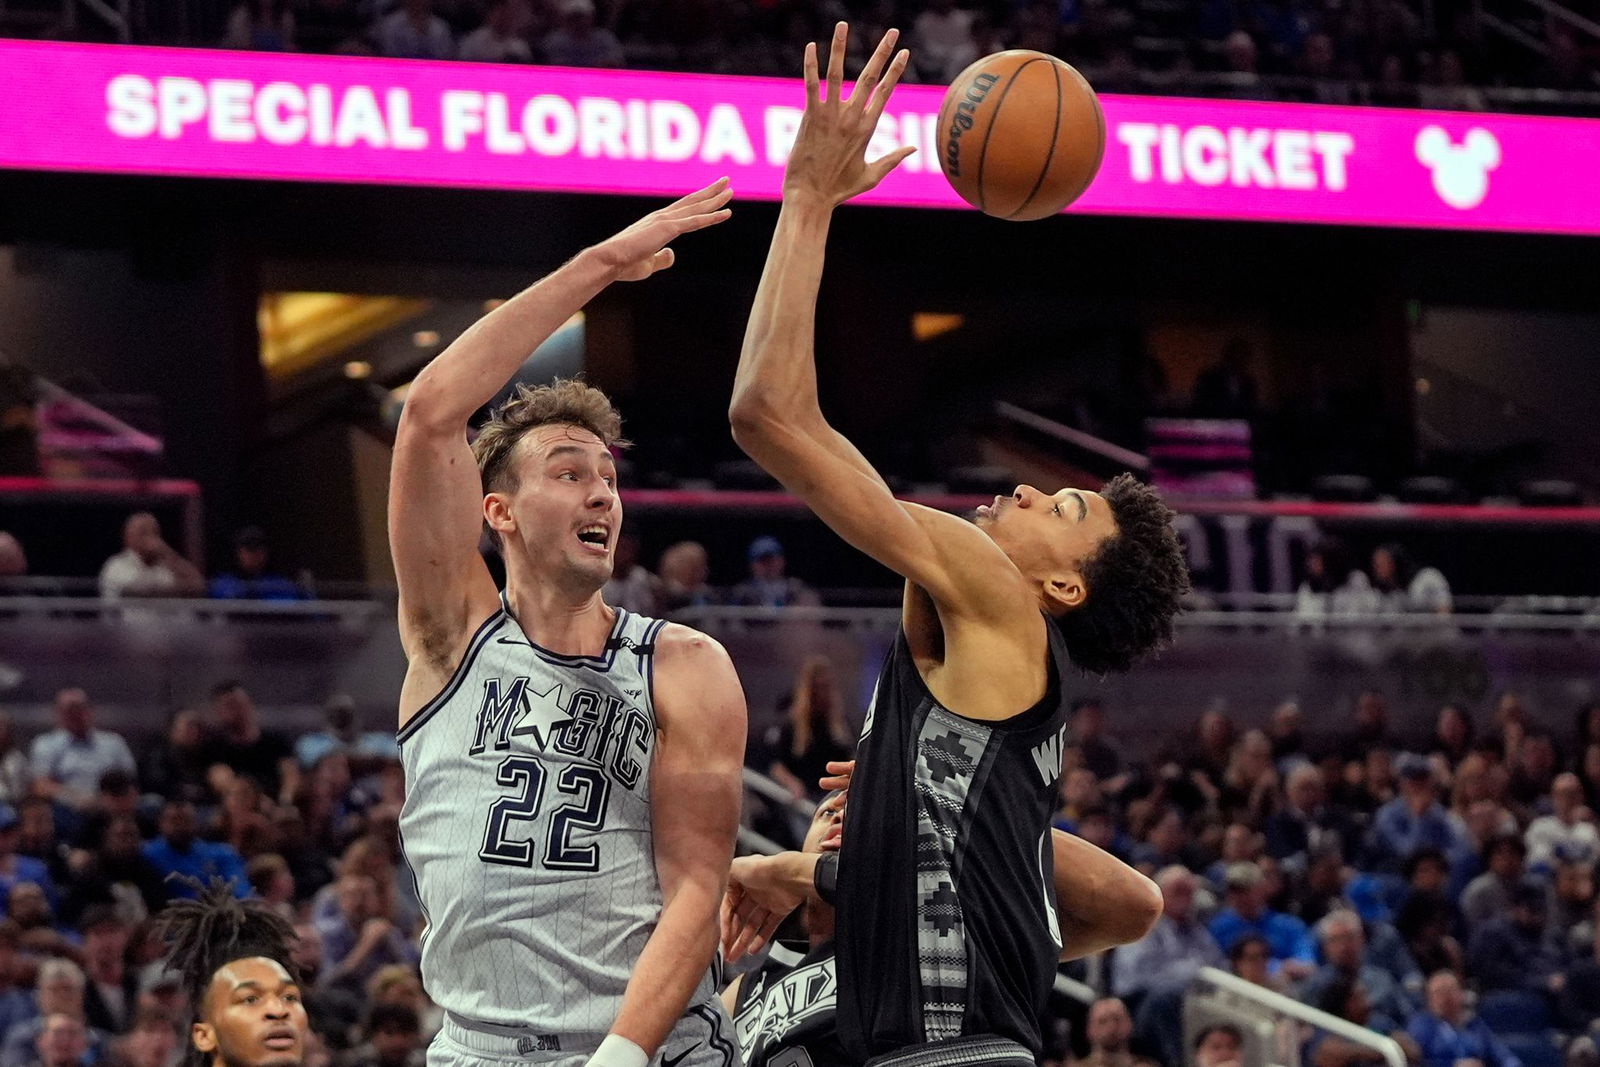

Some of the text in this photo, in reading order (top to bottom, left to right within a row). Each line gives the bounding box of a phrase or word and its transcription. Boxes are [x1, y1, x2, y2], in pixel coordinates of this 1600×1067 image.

[107, 75, 428, 150] SPECIAL
[441, 89, 755, 165] FLORIDA
[1117, 122, 1354, 191] TICKET
[947, 73, 1000, 177] Wilson
[469, 677, 652, 790] MGIC
[478, 755, 612, 872] 22
